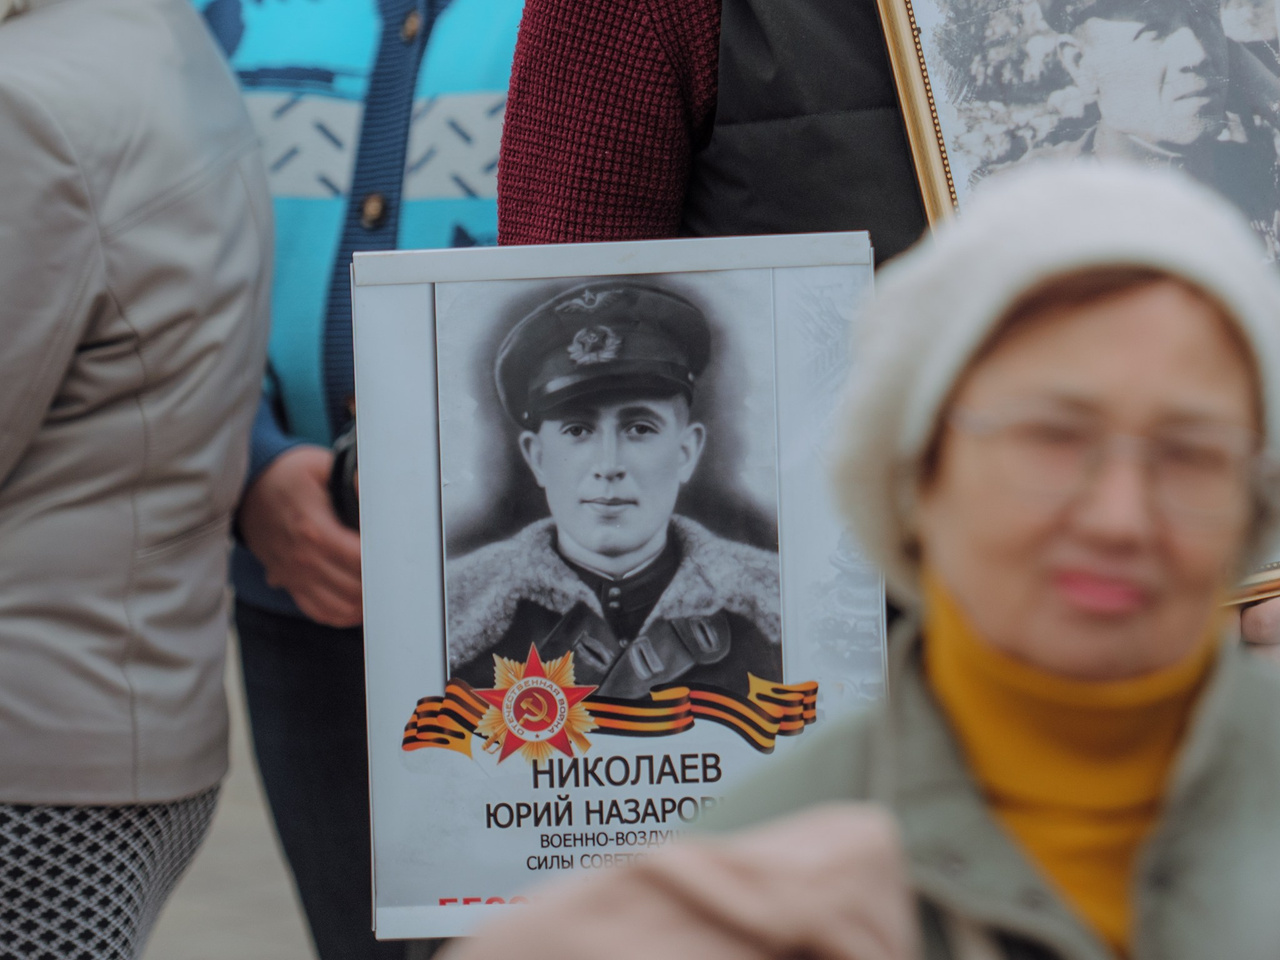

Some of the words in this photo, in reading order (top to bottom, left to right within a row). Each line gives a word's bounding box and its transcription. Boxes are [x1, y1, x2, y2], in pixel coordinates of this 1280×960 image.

[505, 679, 560, 736] ОТЕЧЕСТВЕННАЯ
[532, 752, 723, 789] НИКОЛАЕВ
[485, 794, 573, 829] ЮРИЙ
[526, 854, 574, 871] СИЛЫ
